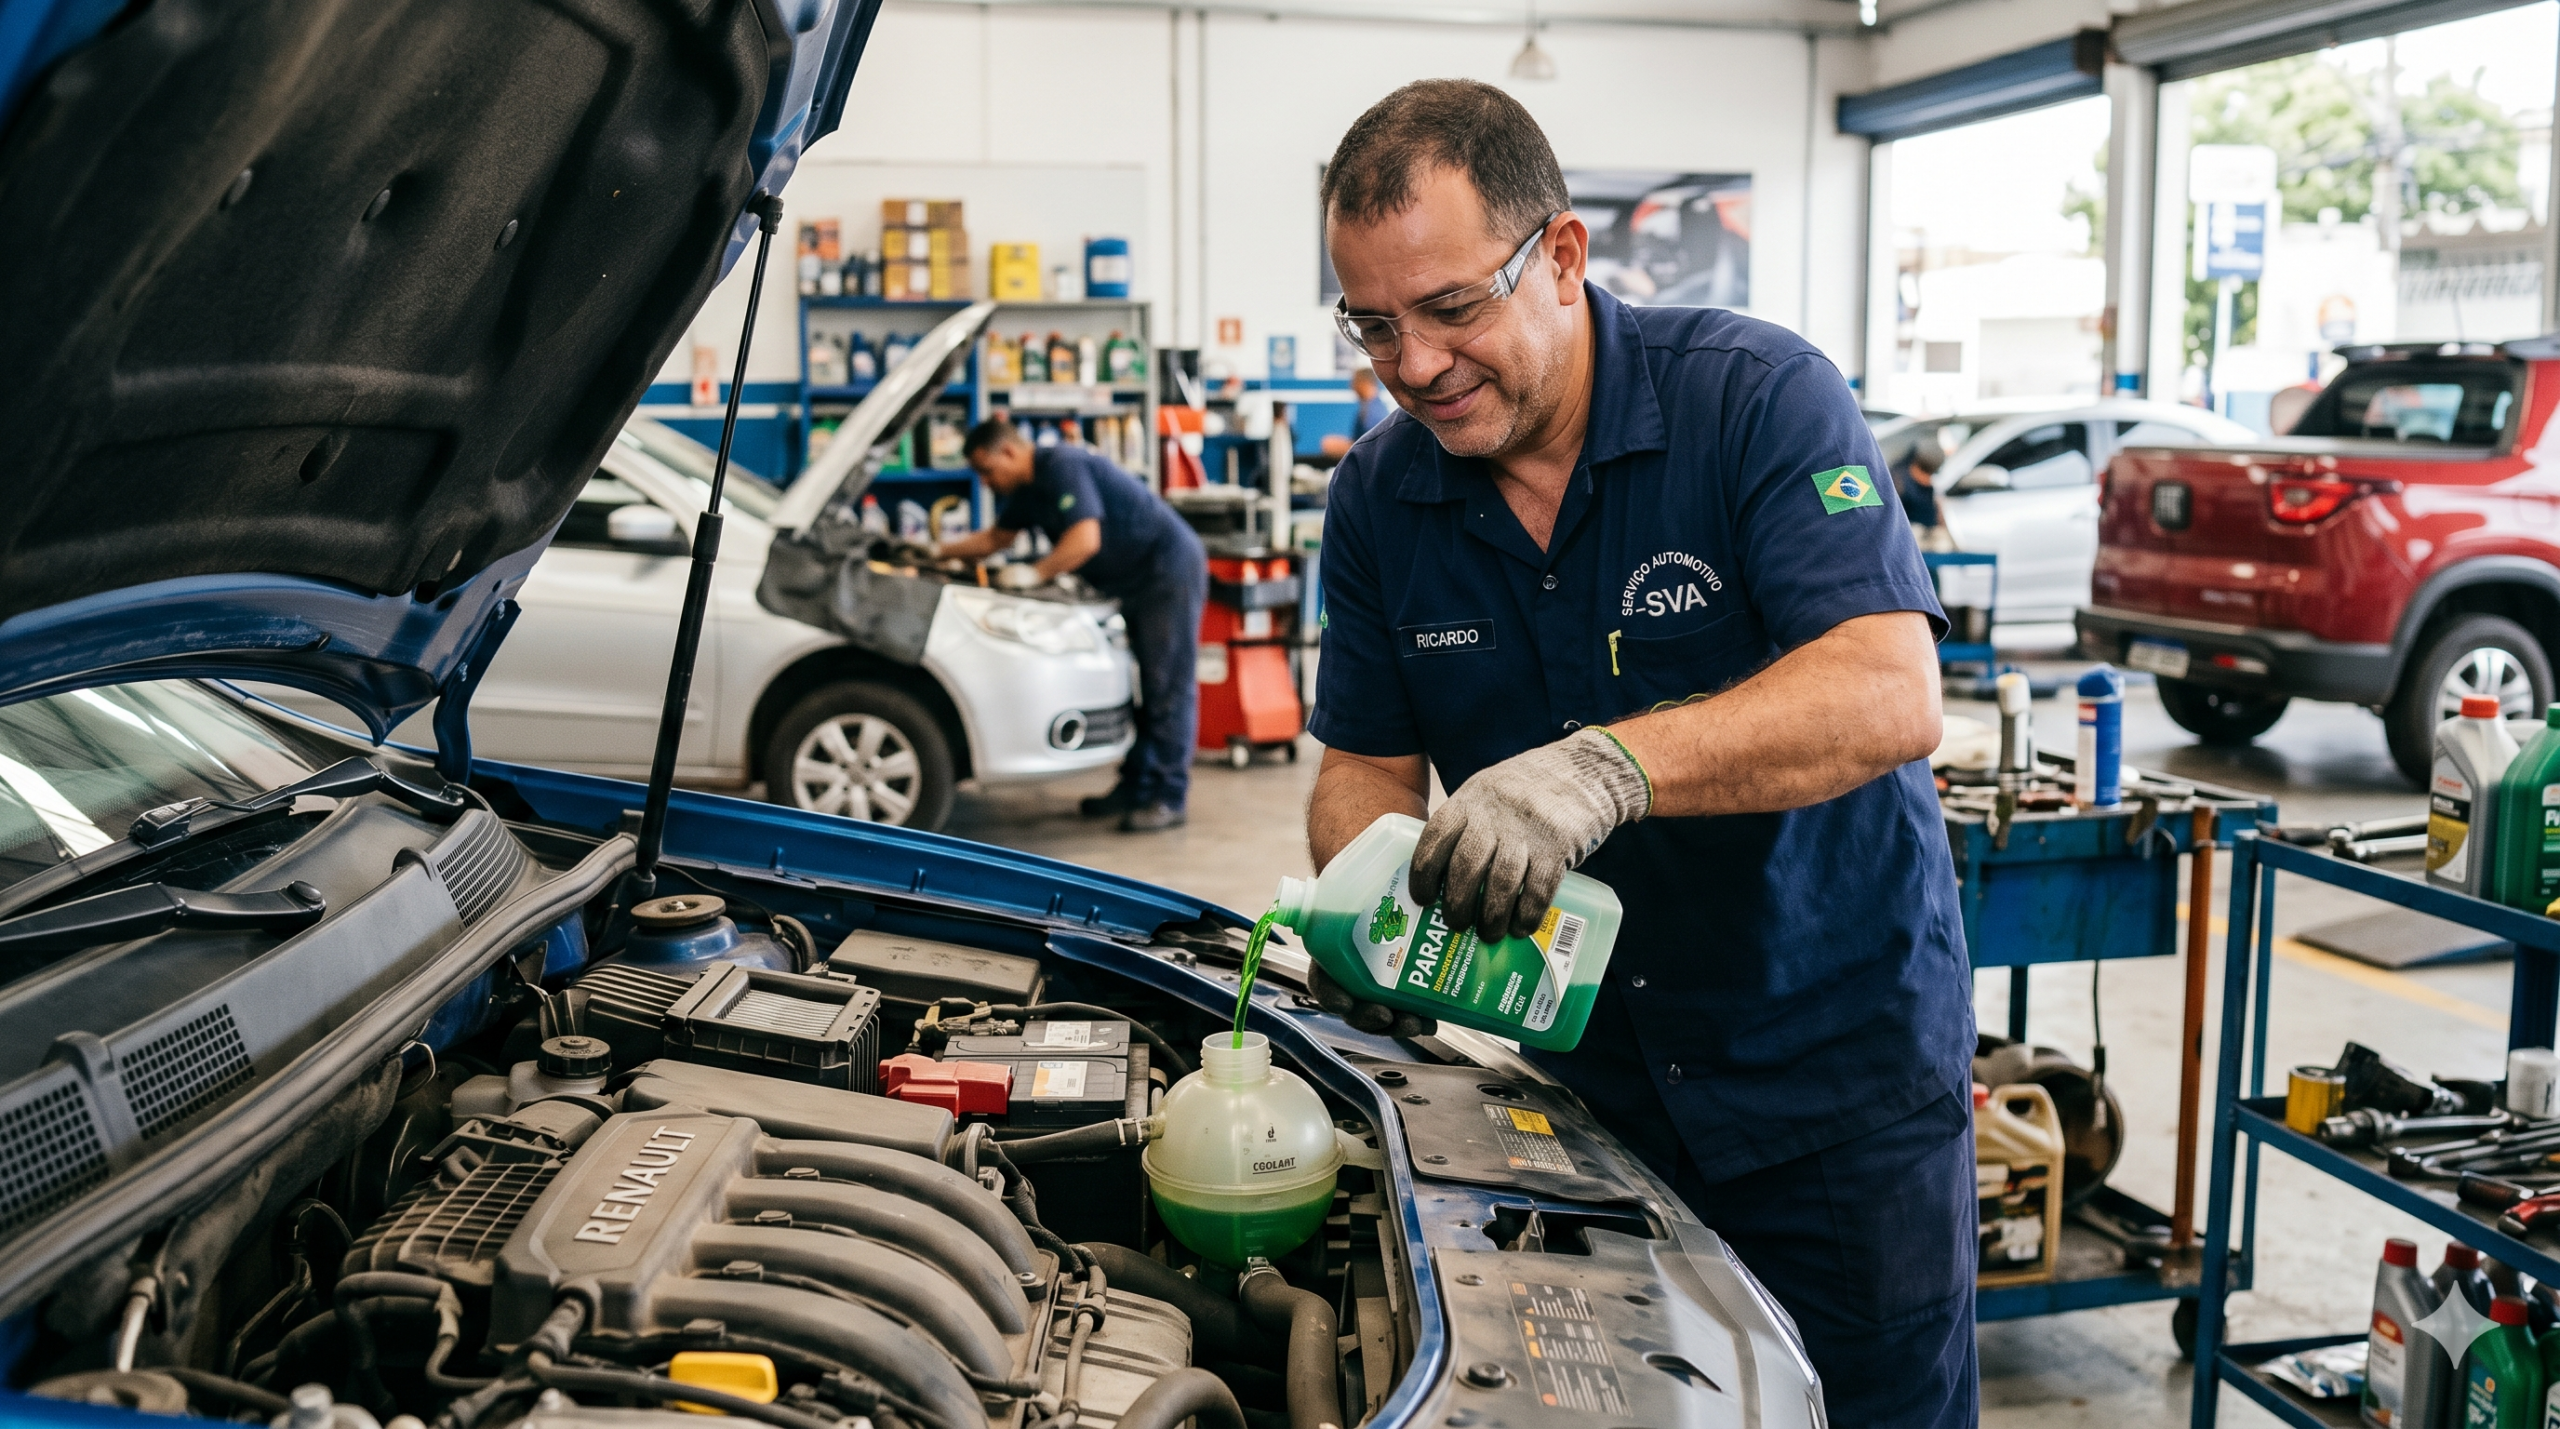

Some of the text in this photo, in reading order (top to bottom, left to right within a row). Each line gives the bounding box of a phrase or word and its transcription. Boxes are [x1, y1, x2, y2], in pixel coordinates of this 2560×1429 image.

[1621, 551, 1723, 616] SERVIÇO AUTOMOTIVO
[1416, 628, 1479, 648] RICARDO
[573, 1125, 696, 1245] RENAULT
